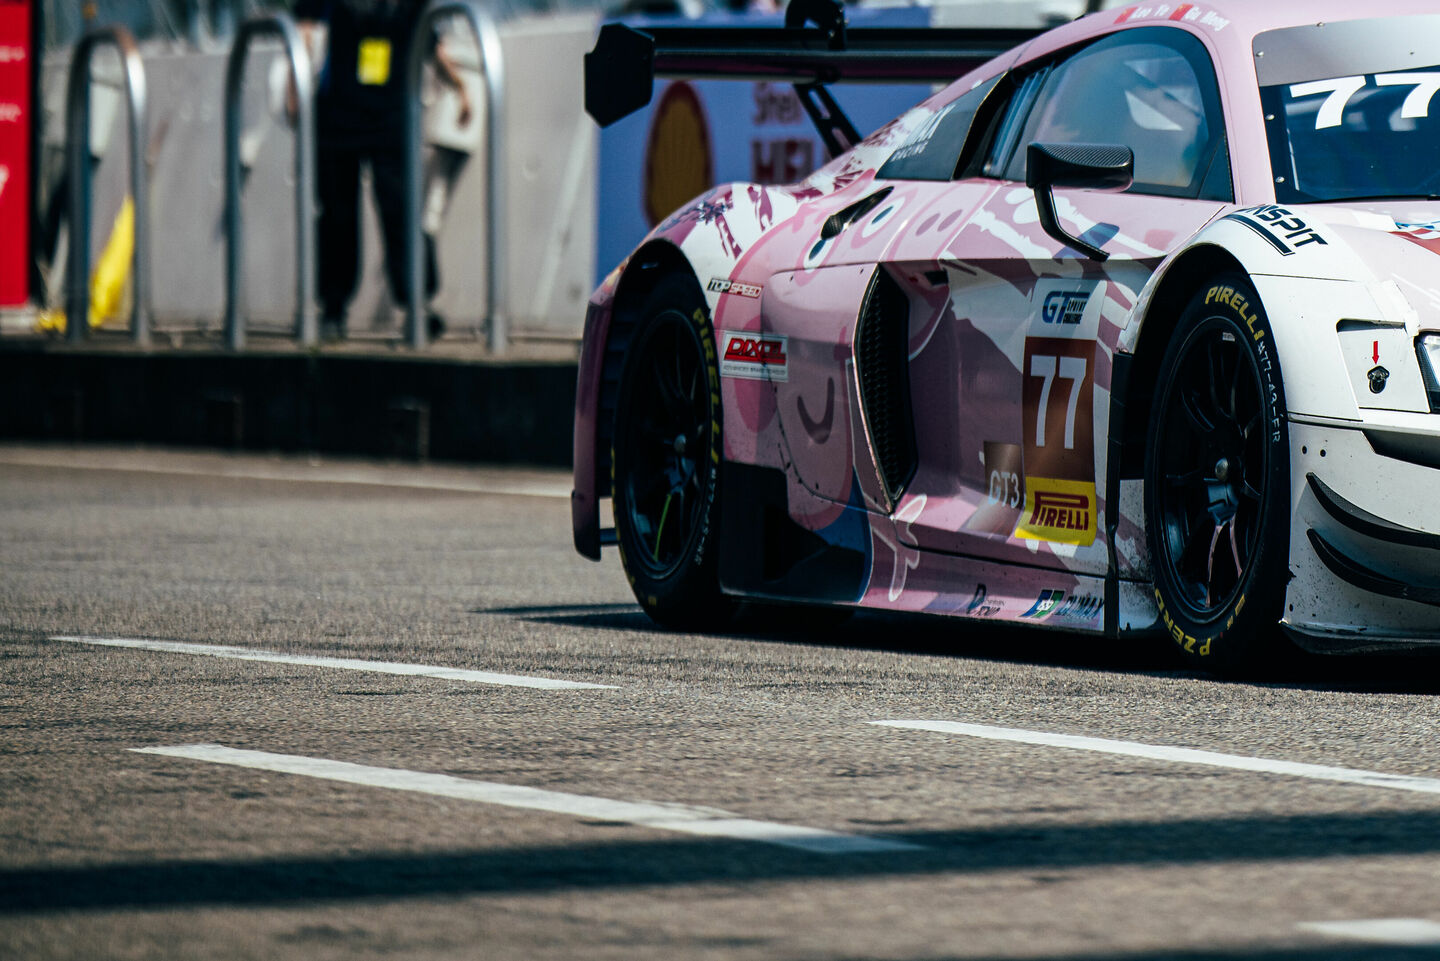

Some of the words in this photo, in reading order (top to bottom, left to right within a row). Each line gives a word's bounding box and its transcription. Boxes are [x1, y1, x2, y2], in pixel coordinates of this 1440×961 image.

[709, 279, 732, 293] TOP
[729, 282, 763, 297] SPEED
[1041, 290, 1078, 325] GT
[1204, 285, 1265, 341] PIRELLI
[692, 305, 721, 465] PIRELLI
[1030, 354, 1088, 450] 77
[986, 469, 1021, 510] GT3
[1028, 490, 1090, 532] PIRELLI
